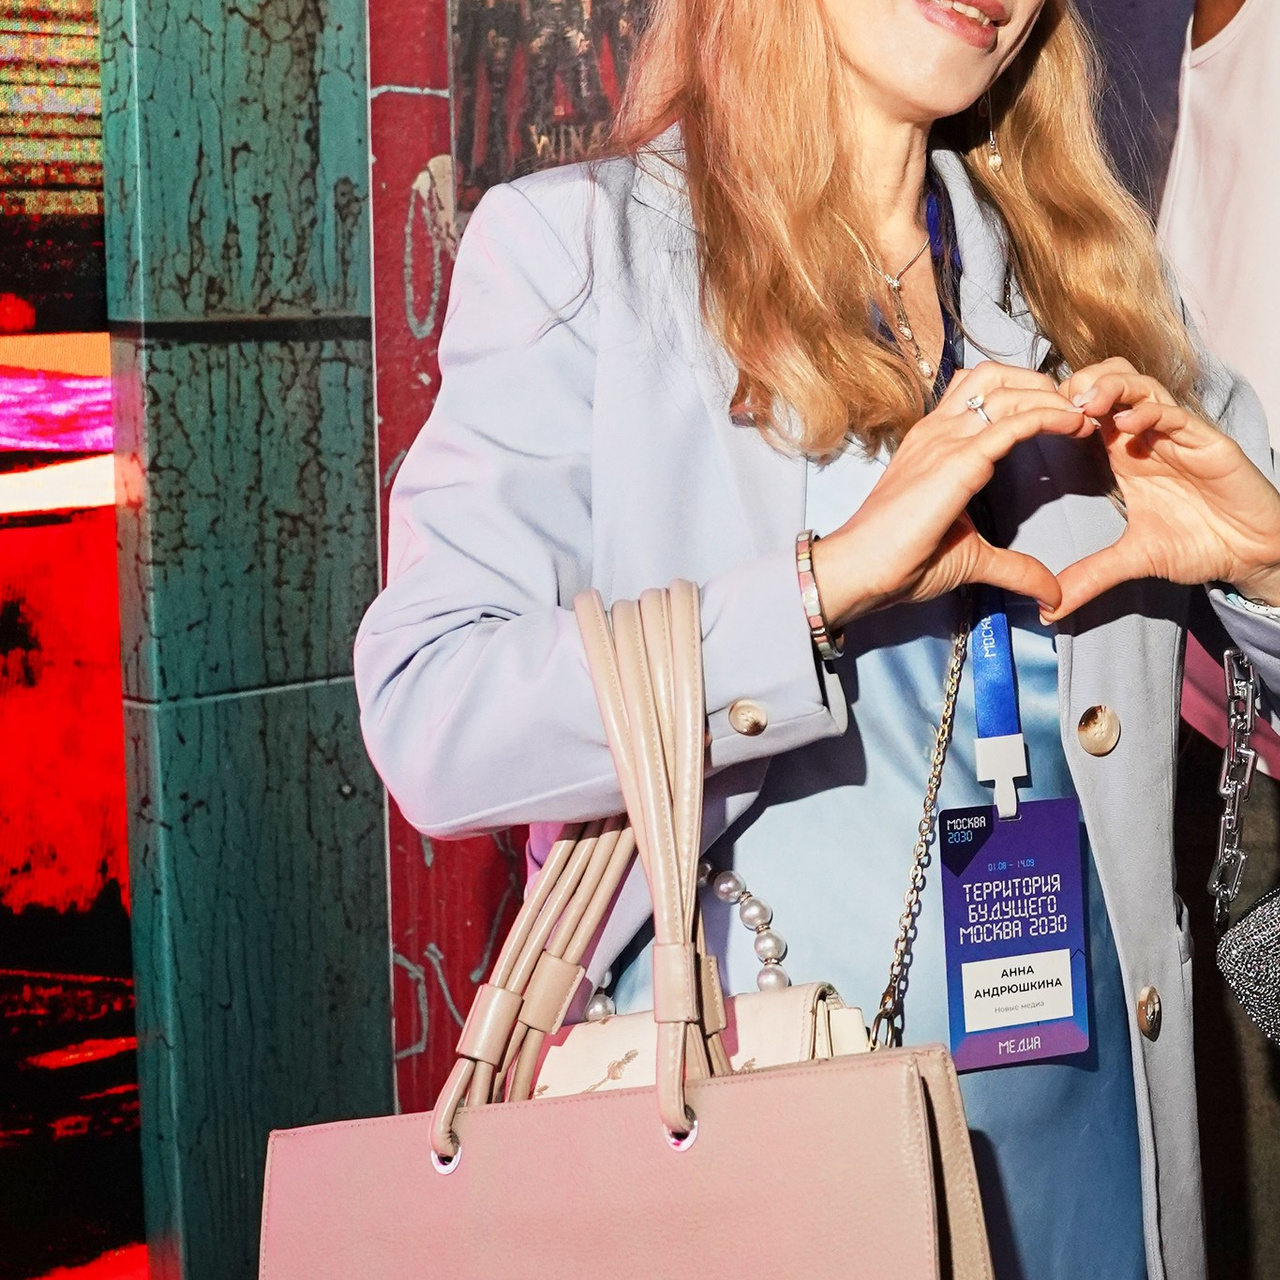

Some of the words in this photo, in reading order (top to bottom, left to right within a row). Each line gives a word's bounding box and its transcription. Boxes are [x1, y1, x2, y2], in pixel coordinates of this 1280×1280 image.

[947, 816, 986, 830] МОСКВА
[948, 831, 973, 843] 2030
[988, 862, 1006, 871] 01.08
[963, 874, 1061, 902] ТЕРРИТОРИЯ
[968, 895, 1057, 923] БУДУЩЕГО
[960, 920, 1022, 945] МОСКВА
[1029, 915, 1068, 936] 2030
[1001, 965, 1034, 978] АННА
[974, 978, 1062, 999] АНДРЮШКИНА
[994, 1004, 1019, 1014] Новые
[1021, 1001, 1045, 1011] медиа
[998, 1036, 1041, 1055] МЕДИА
